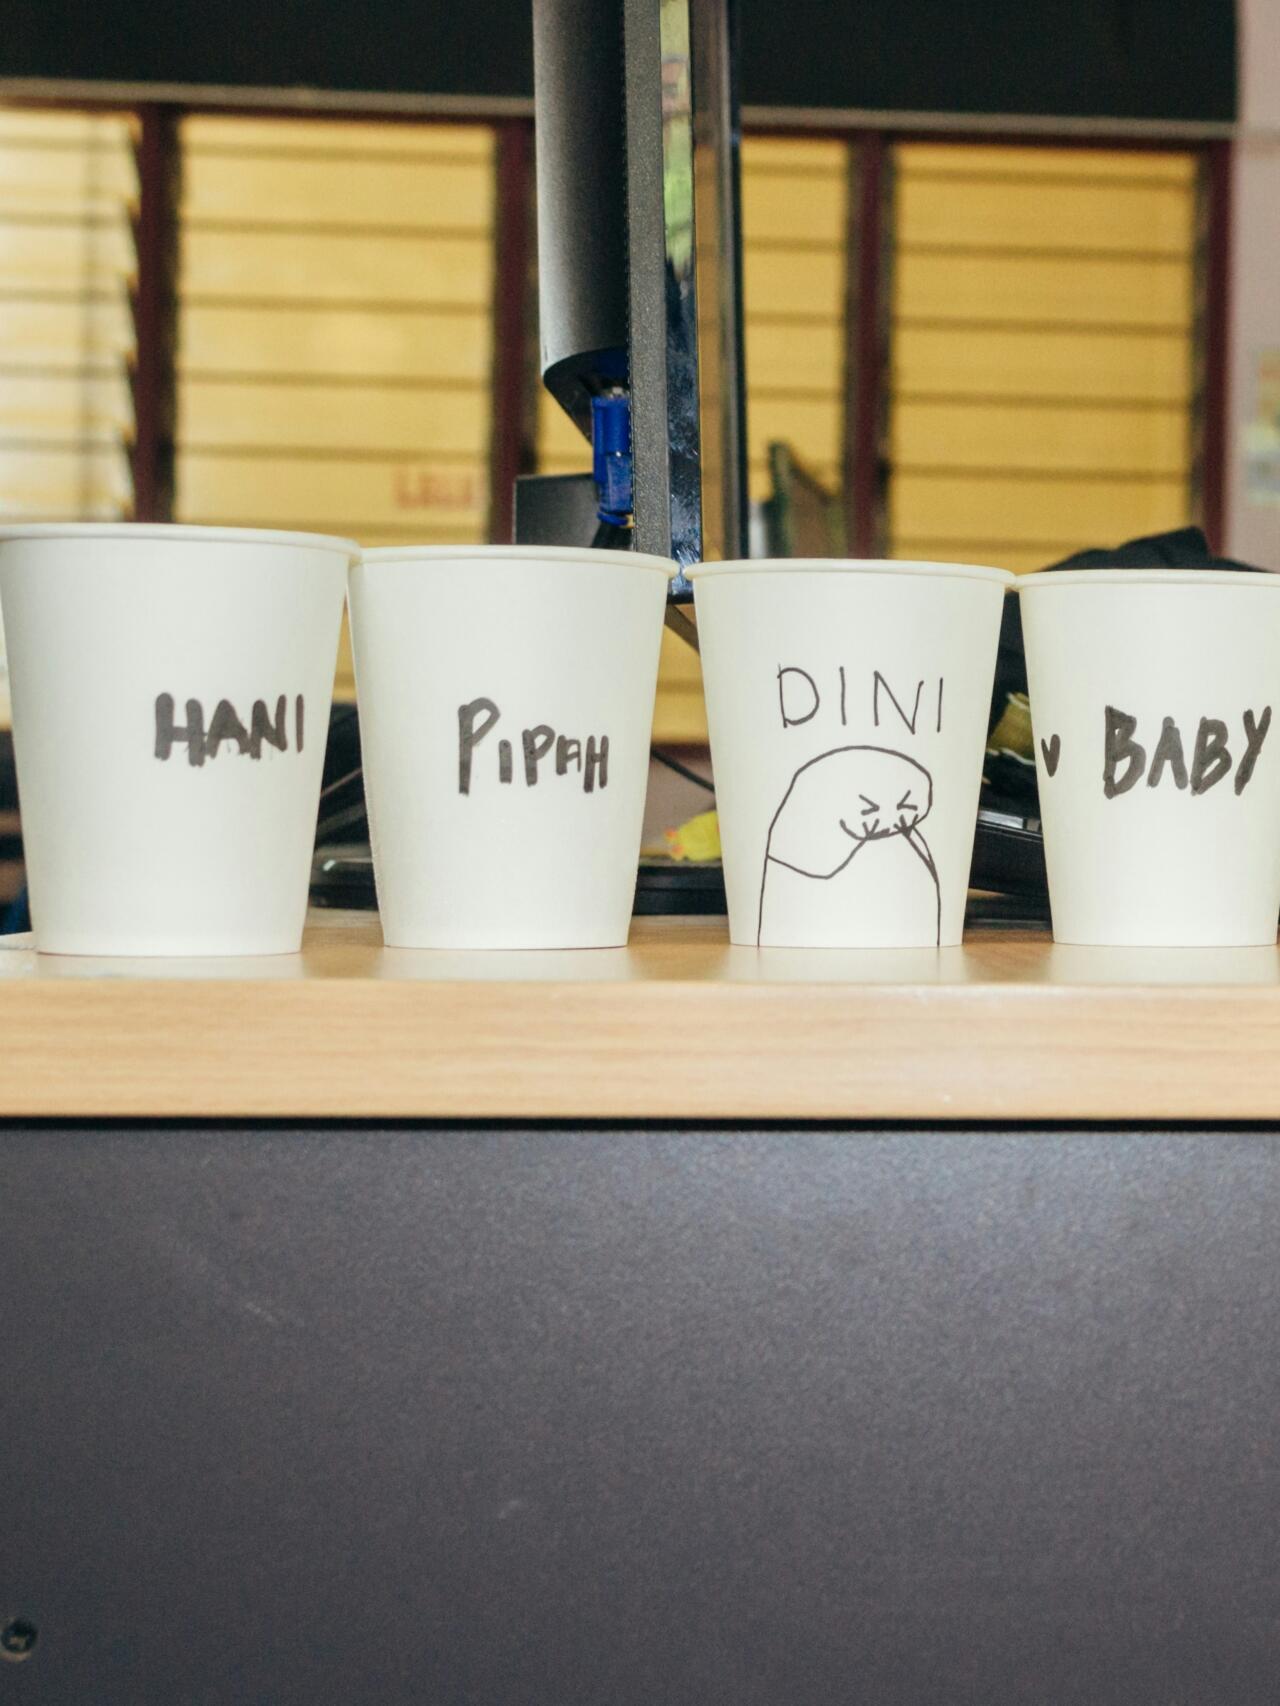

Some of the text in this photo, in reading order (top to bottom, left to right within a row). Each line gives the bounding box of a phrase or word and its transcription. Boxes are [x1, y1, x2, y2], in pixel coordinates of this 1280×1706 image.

[154, 692, 305, 767] HANI
[777, 665, 945, 735] DINI
[1102, 705, 1273, 800] BABY
